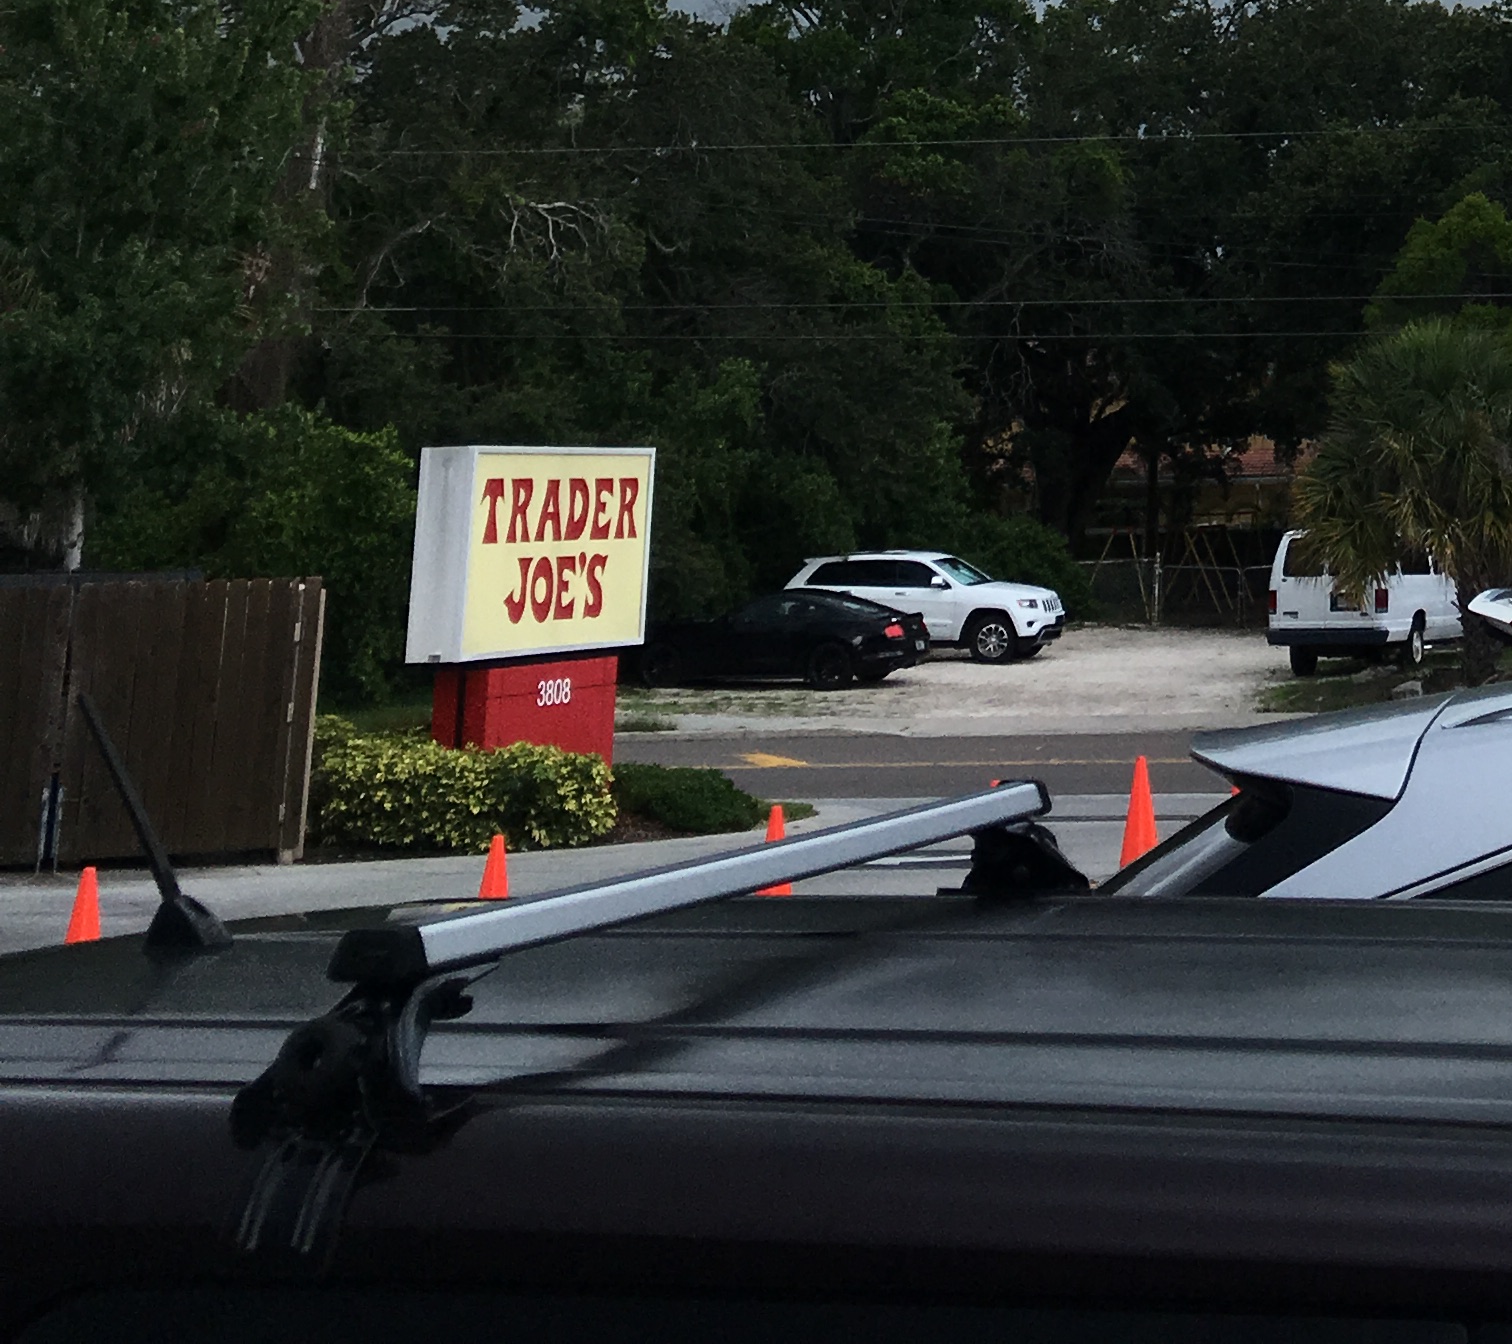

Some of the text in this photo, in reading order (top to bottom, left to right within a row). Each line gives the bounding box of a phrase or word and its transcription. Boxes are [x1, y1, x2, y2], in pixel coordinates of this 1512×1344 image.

[480, 477, 639, 544] TRADER
[503, 551, 609, 624] JOE'S
[536, 677, 571, 707] 3808
